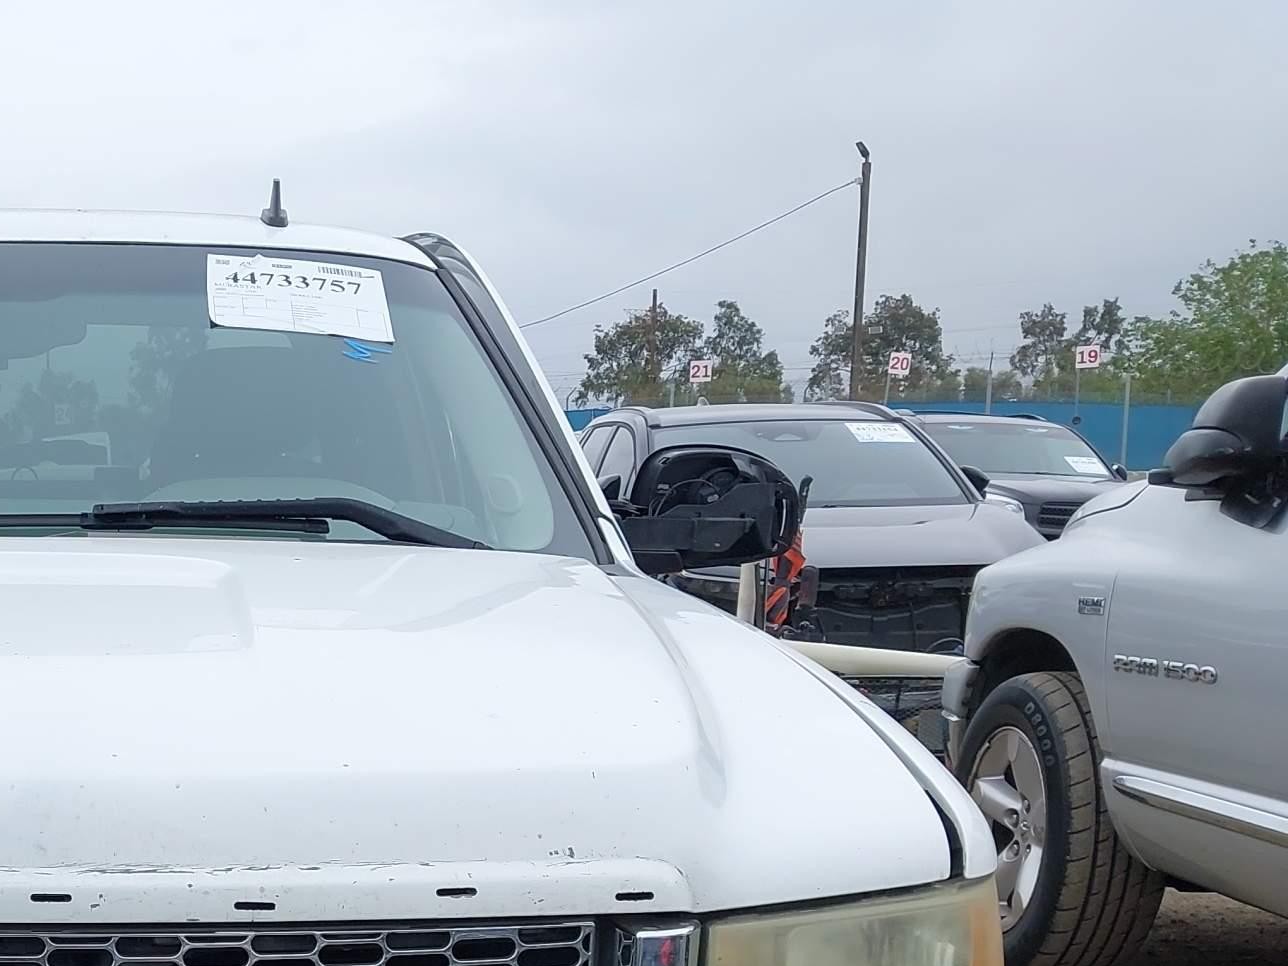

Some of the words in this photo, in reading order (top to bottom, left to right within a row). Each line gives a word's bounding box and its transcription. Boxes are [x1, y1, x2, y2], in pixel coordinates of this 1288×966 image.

[225, 271, 362, 295] 44733757
[889, 356, 909, 371] 20
[1077, 349, 1098, 364] 19
[691, 364, 710, 378] 21
[1113, 654, 1158, 677] RAM
[1162, 660, 1218, 684] 1500
